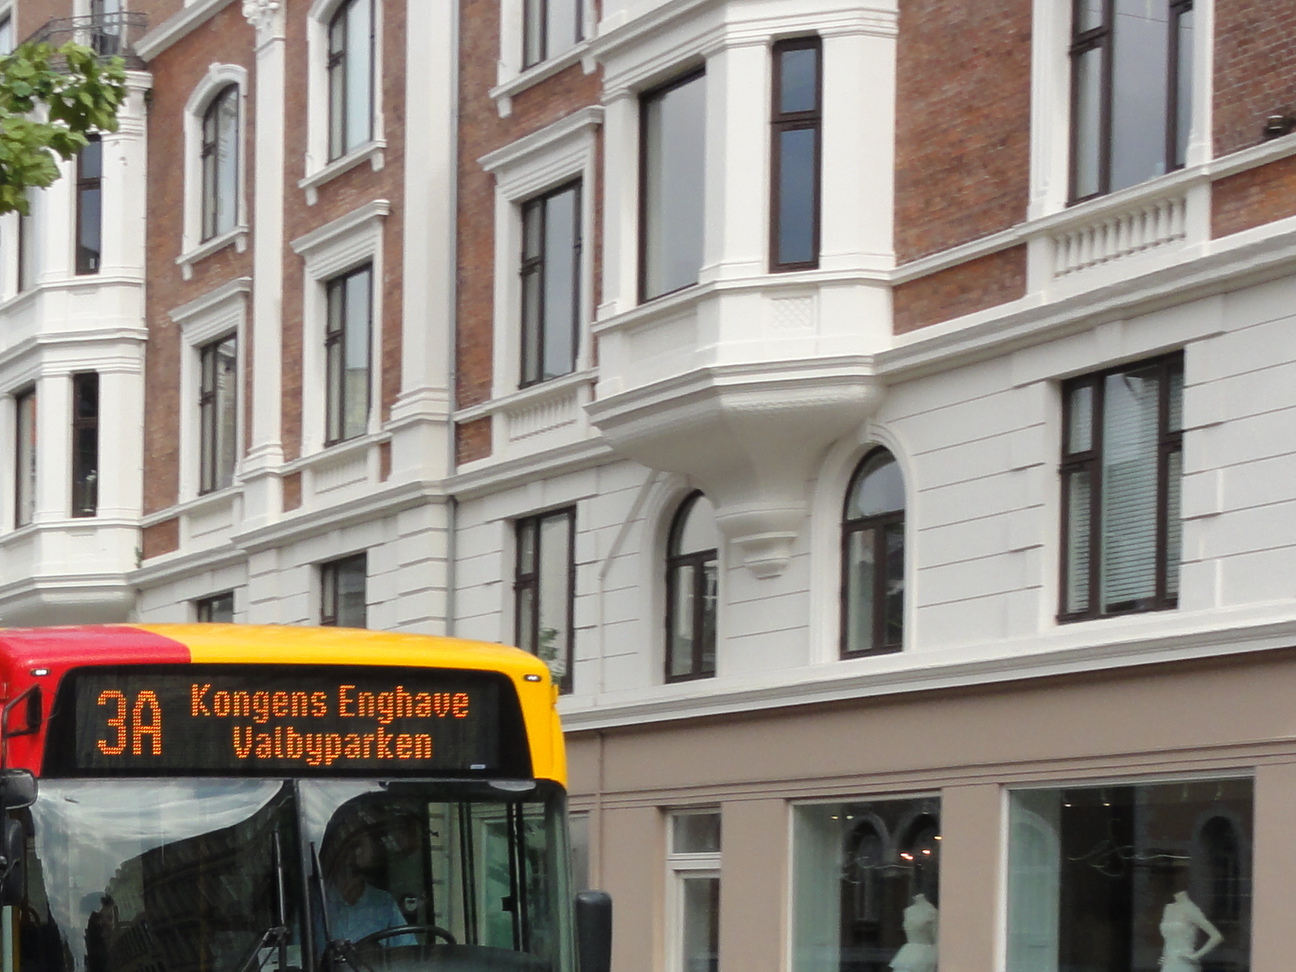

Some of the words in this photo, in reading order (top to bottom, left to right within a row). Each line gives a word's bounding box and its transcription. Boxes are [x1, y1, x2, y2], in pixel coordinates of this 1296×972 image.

[97, 690, 162, 756] 3A
[190, 683, 328, 723] Kongens
[339, 685, 469, 724] Enghave
[233, 726, 432, 765] Valbyparken
